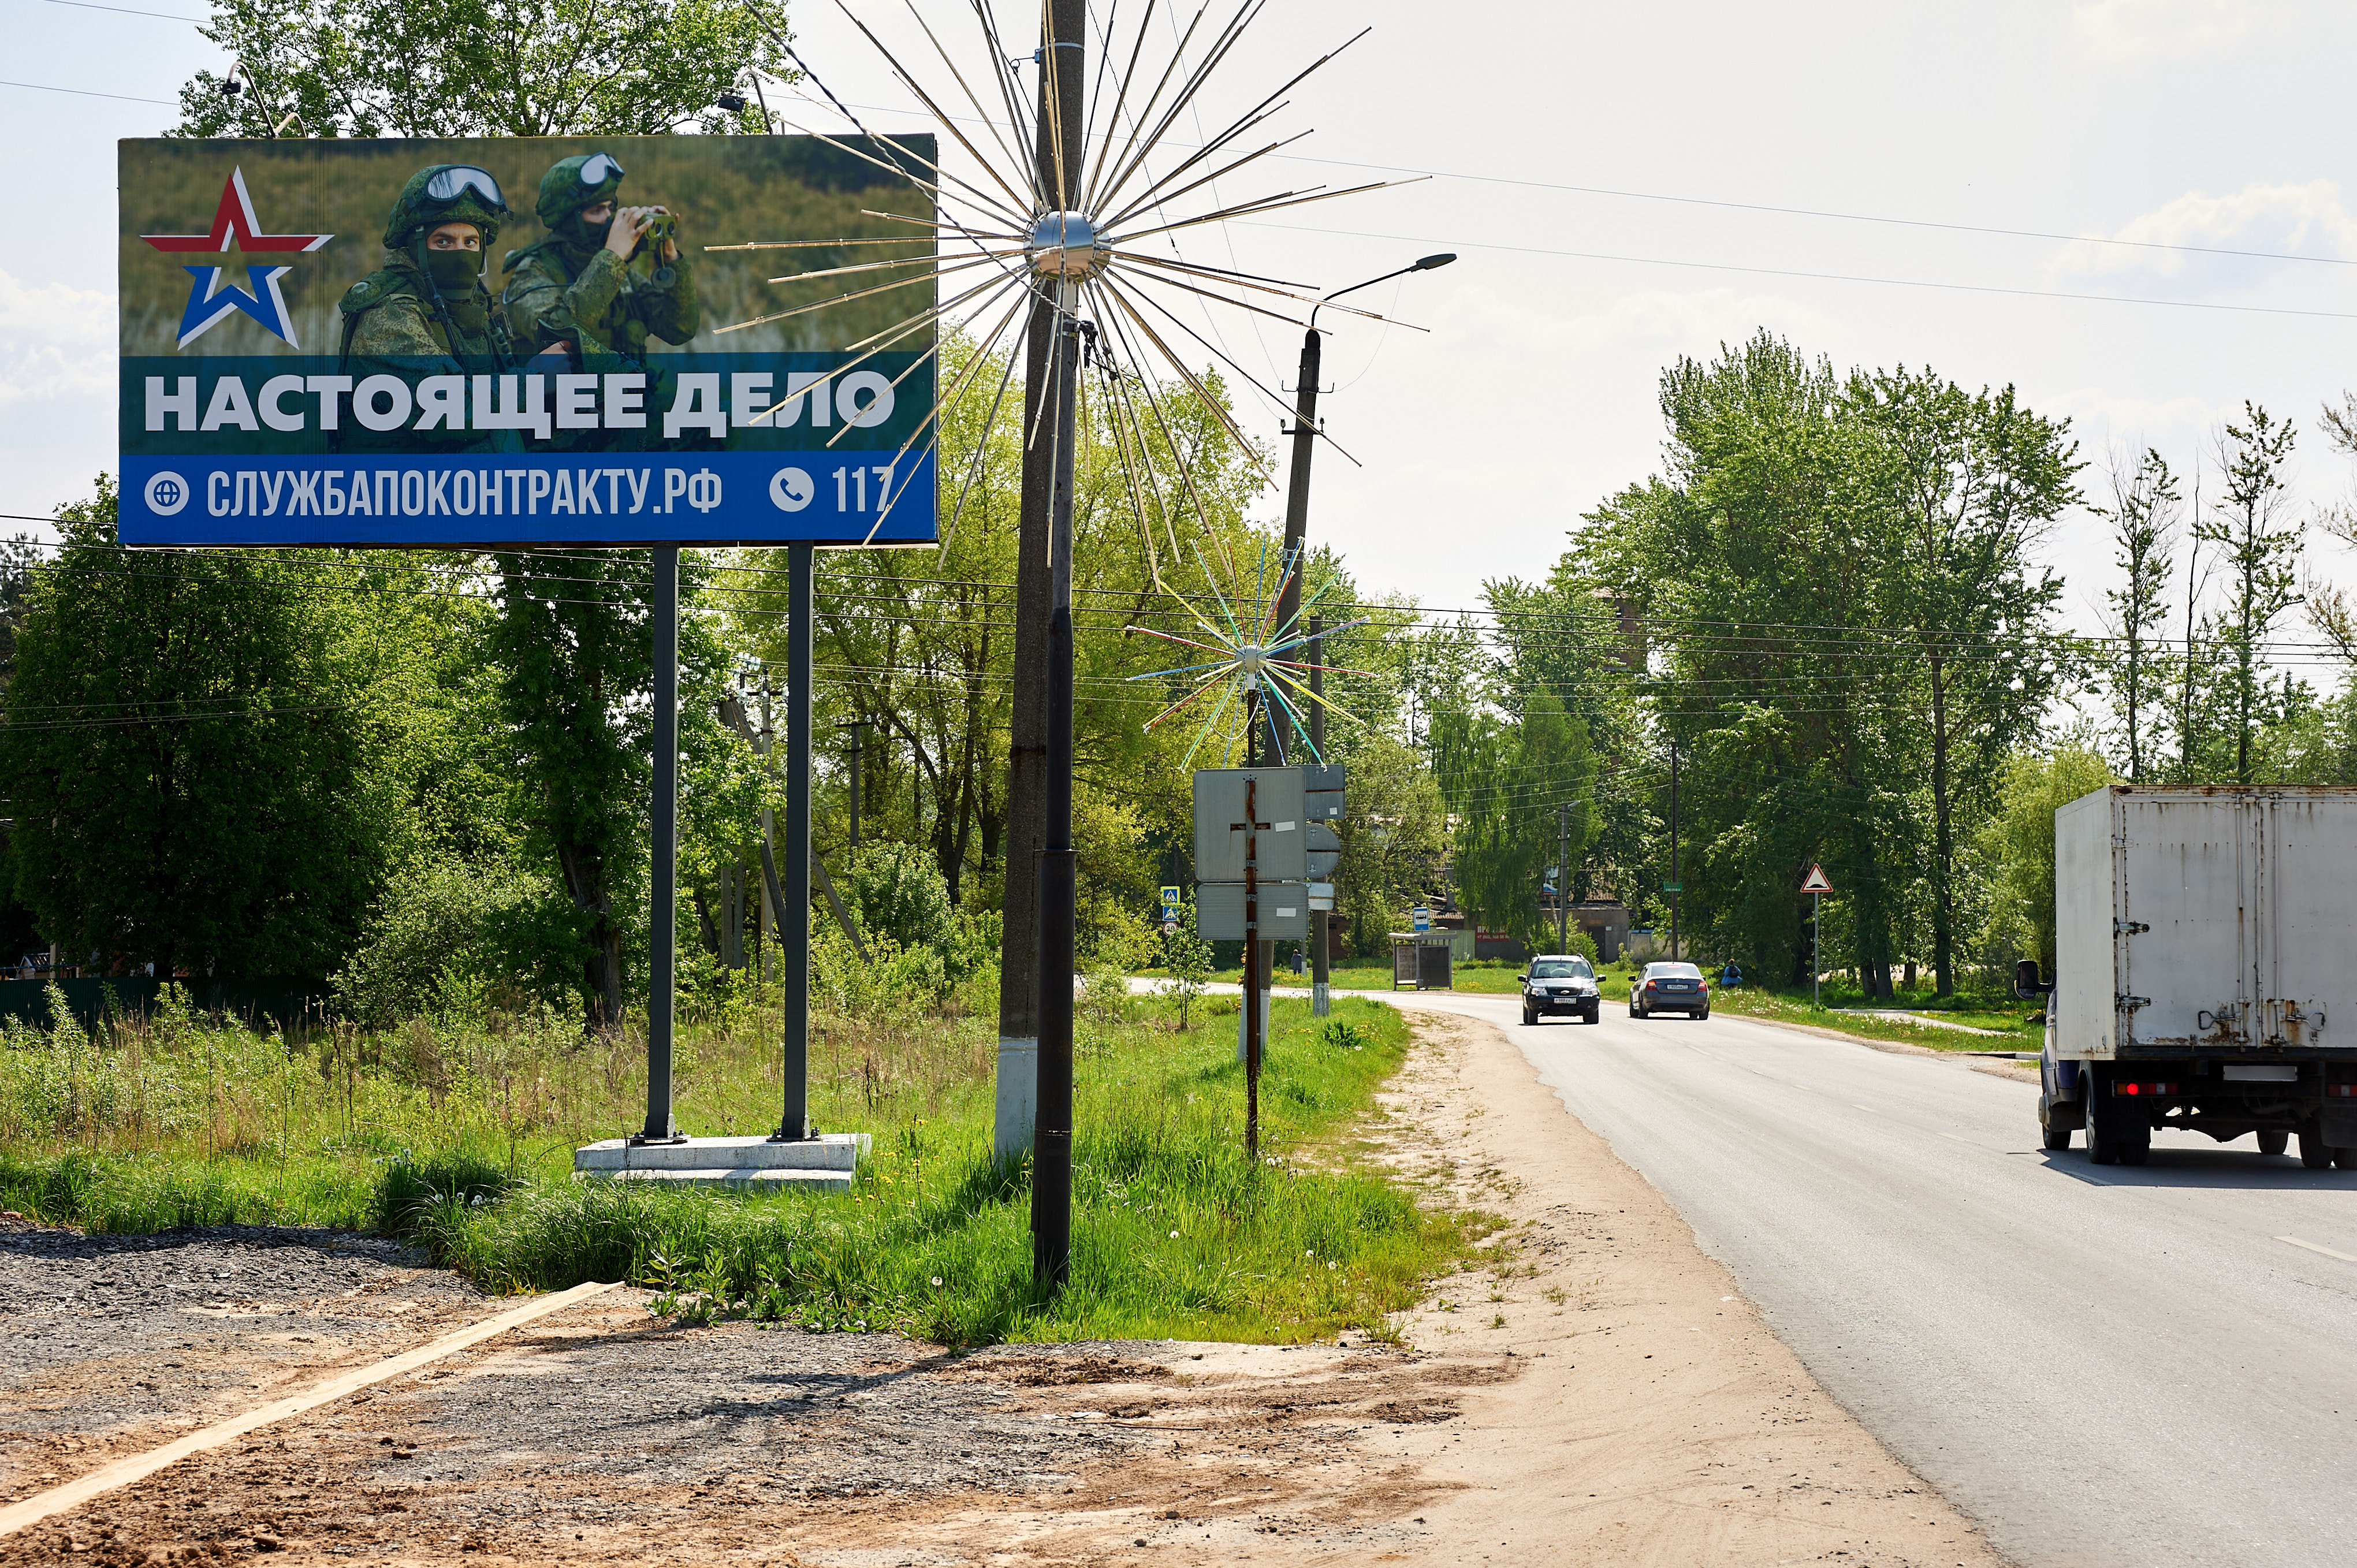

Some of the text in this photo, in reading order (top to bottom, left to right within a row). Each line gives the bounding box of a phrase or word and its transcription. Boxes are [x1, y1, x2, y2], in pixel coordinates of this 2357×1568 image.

[144, 370, 895, 440] НАСТОЯЩЕЕ ДЕЛО
[207, 467, 723, 517] СЛУЖБАПОКОНТРАКТУ.РФ
[832, 465, 895, 512] 117
